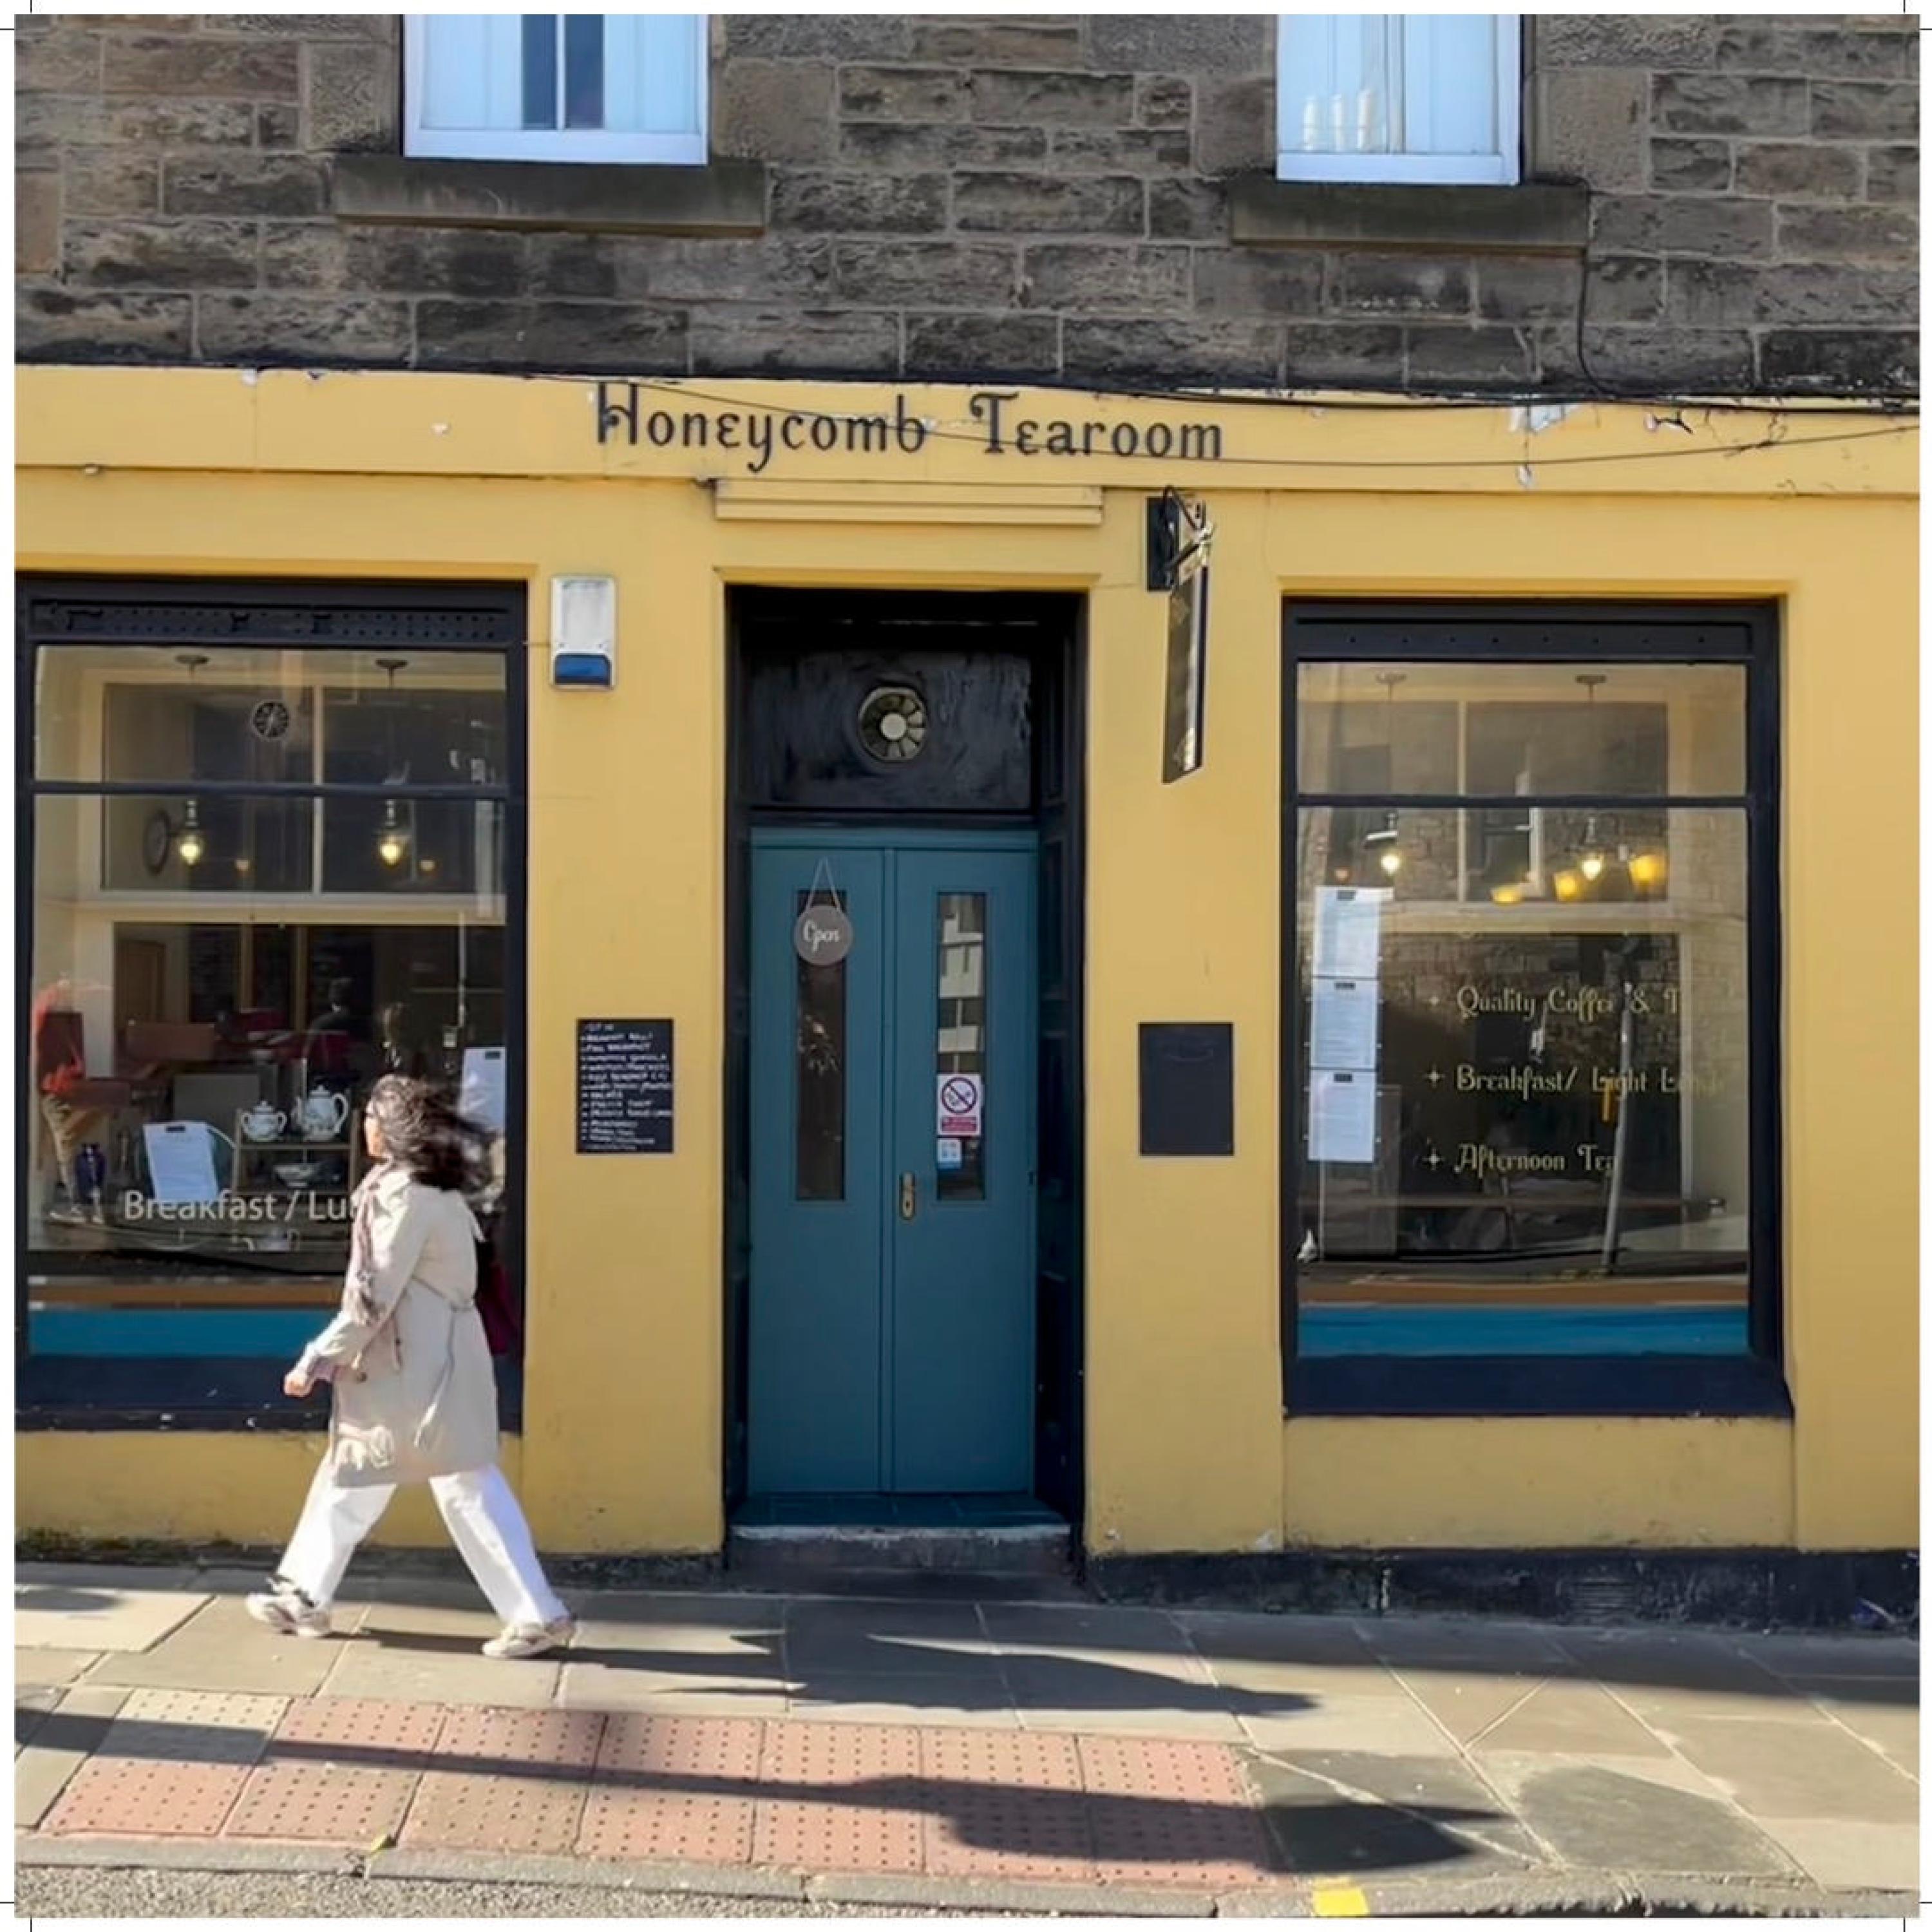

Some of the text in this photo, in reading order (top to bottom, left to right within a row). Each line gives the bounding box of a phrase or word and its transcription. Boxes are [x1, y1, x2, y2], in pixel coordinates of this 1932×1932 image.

[596, 381, 1224, 473] Honeycomb Tearoom
[1457, 985, 1537, 1021] Quality
[1453, 1142, 1566, 1179] Afternoon
[124, 1189, 278, 1220] Breakfast
[308, 1190, 355, 1220] Lu
